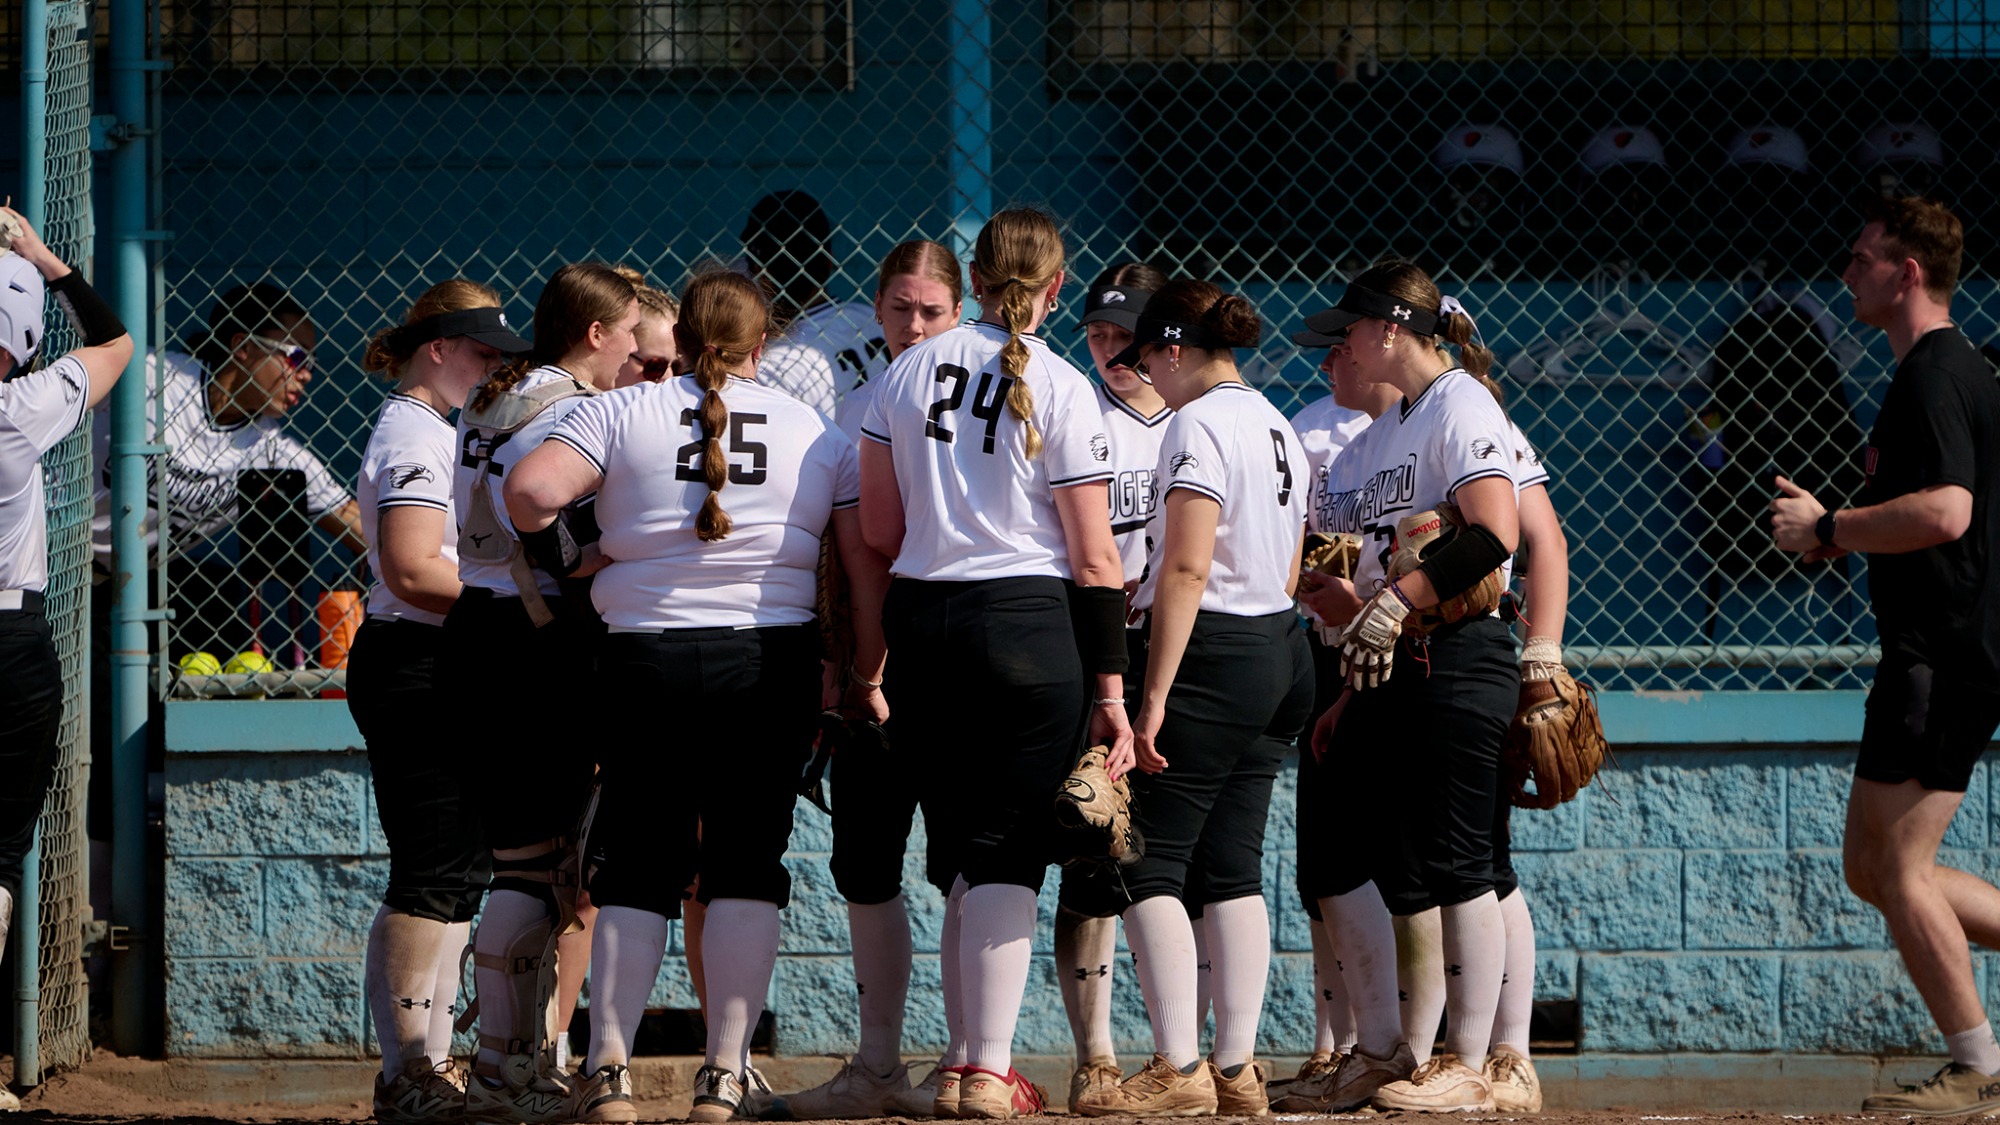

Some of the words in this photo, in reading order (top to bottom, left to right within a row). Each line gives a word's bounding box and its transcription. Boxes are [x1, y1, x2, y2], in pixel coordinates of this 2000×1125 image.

[675, 408, 767, 485] 25
[925, 363, 1013, 454] 24
[1269, 428, 1292, 506] 9
